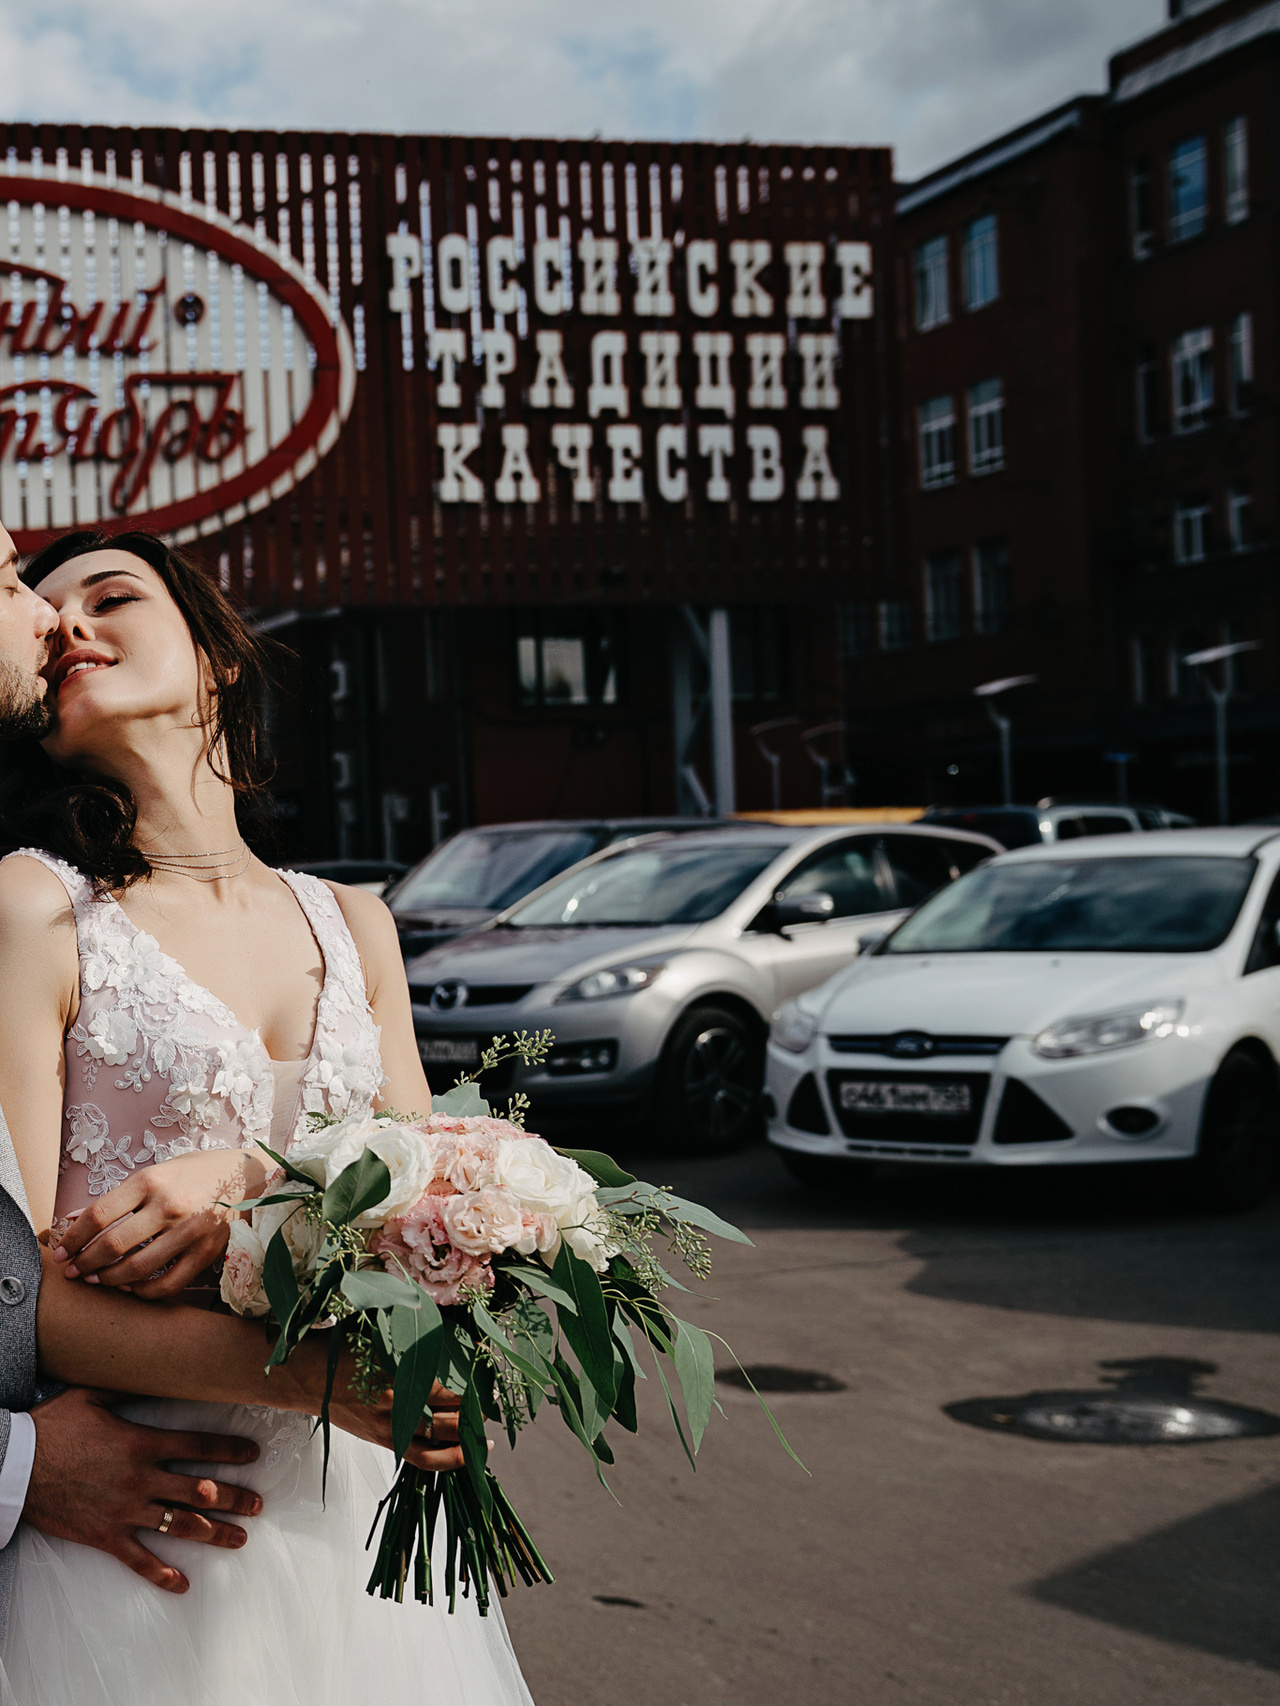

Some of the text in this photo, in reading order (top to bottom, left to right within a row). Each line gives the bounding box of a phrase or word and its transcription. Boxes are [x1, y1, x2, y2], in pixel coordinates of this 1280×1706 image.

[386, 232, 874, 320] РОССИЙСКИЕ
[429, 328, 840, 420] ТРАДИЦИИ
[437, 424, 840, 503] КАЧЕСТВА
